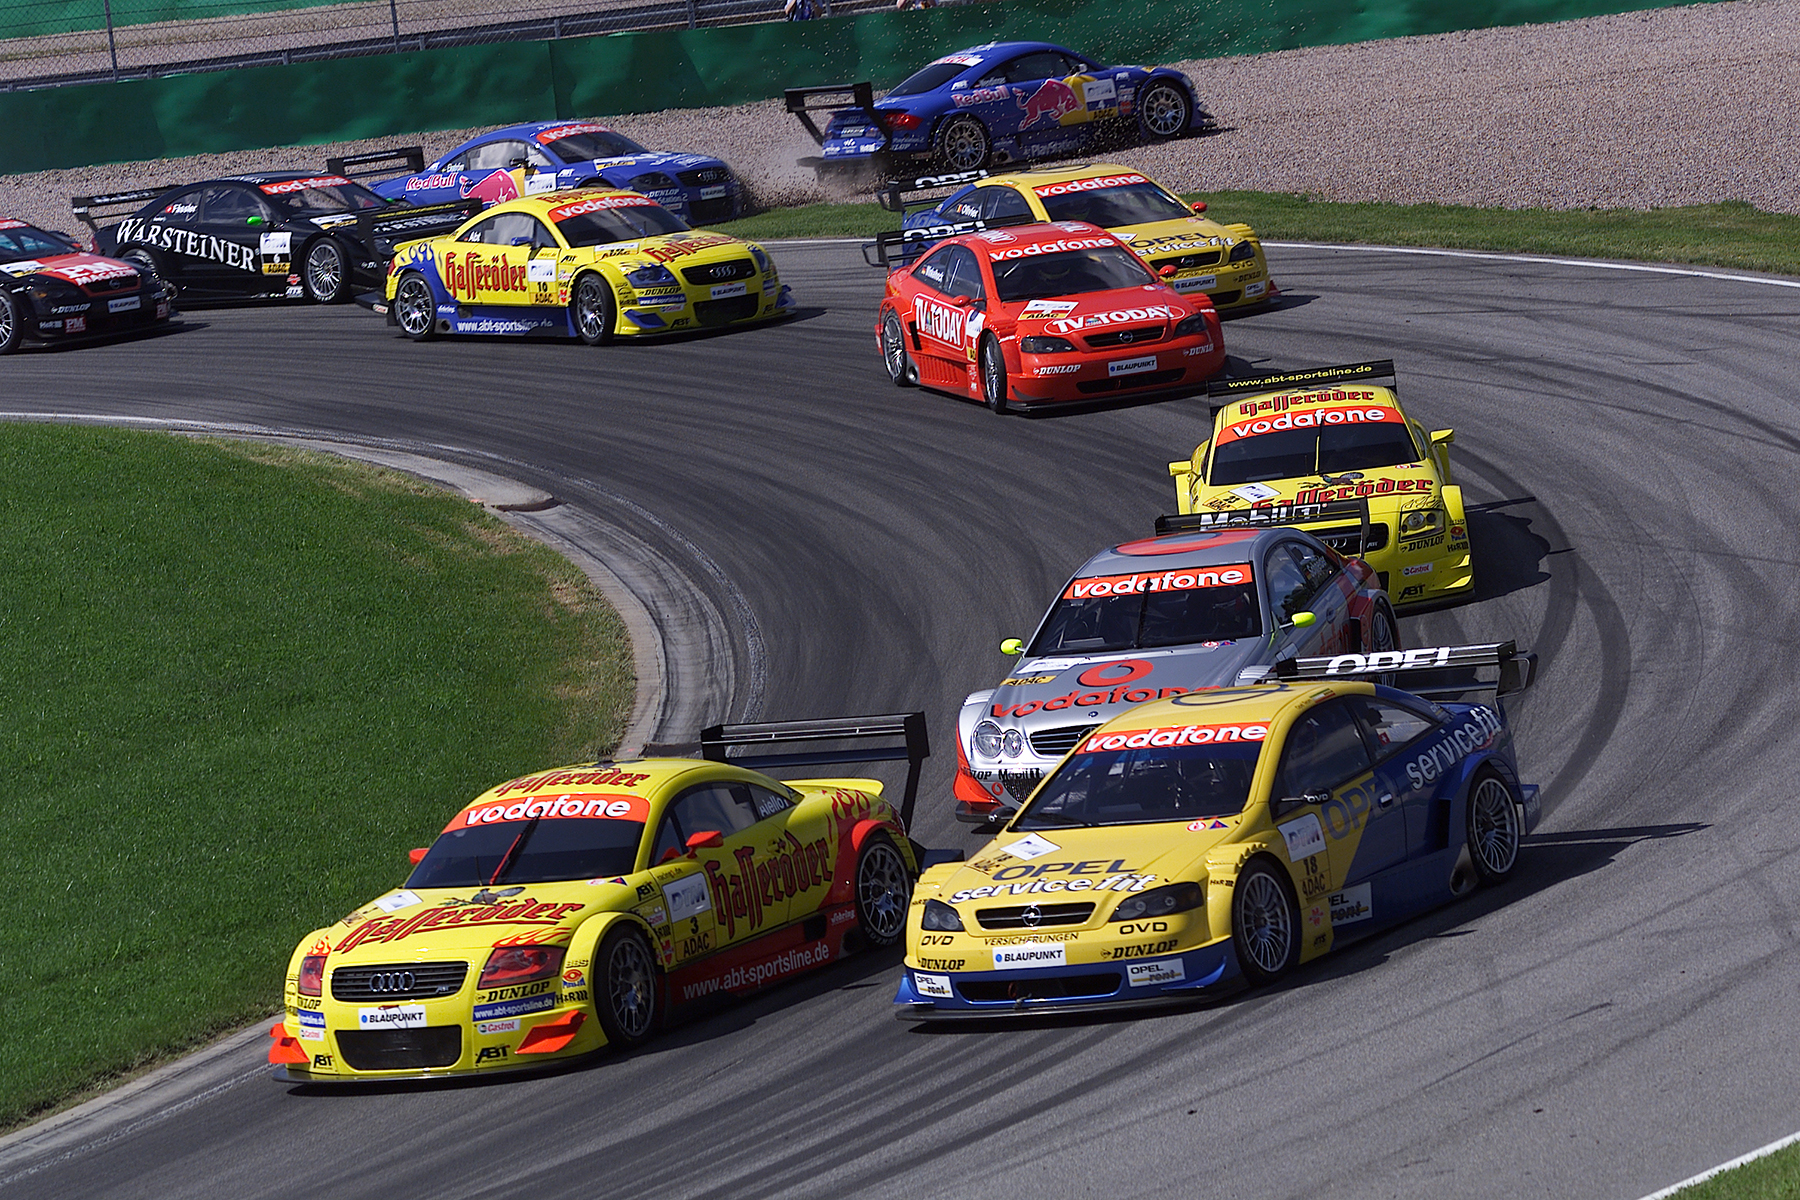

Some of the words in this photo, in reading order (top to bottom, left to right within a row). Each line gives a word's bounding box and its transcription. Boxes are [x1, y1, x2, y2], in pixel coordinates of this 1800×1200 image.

[951, 91, 980, 108] Red
[980, 85, 1011, 104] Bull
[405, 177, 432, 192] Red
[430, 172, 459, 189] Bull
[915, 168, 990, 189] OPEL
[1035, 173, 1147, 198] vodafone
[648, 188, 680, 199] DUNLOP
[556, 195, 652, 218] vodafone
[903, 220, 988, 243] OPEL
[1128, 231, 1220, 249] OPEL
[988, 235, 1116, 262] vodafone
[273, 253, 280, 264] 6
[644, 287, 682, 297] DUNLOP
[1180, 278, 1216, 289] BLAUPUNKT
[56, 303, 91, 314] DUNLOP
[66, 317, 86, 329] PM
[670, 317, 691, 329] ABT
[915, 296, 929, 333] TV
[931, 302, 965, 347] TODAY
[1052, 315, 1086, 334] TV
[1098, 304, 1175, 325] TODAY
[1039, 364, 1081, 375] DUNLOP
[1116, 359, 1156, 372] BLAUPUNKT
[1228, 364, 1373, 389] www.abt-sportsline.de
[1232, 407, 1386, 438] vodafone
[1200, 506, 1288, 531] Mobil
[1408, 534, 1446, 552] DUNLOP
[1409, 564, 1430, 575] Castrol
[1073, 568, 1244, 598] vodafone
[1398, 584, 1425, 600] ABT
[1326, 646, 1451, 675] OPEL
[1009, 675, 1047, 687] ADAC
[1085, 723, 1268, 752] vodafone
[465, 793, 632, 826] vodafone
[758, 795, 785, 818] Aiello
[1288, 823, 1321, 851] DTM
[992, 858, 1141, 881] OPEL
[1303, 856, 1319, 876] 18
[636, 882, 656, 902] ABT
[1302, 874, 1326, 897] ADAC
[671, 882, 706, 913] DTM
[690, 916, 700, 935] 3
[1119, 921, 1168, 935] OVD
[683, 932, 710, 958] ADAC
[921, 935, 955, 946] OVD
[983, 932, 1080, 947] VERSICHERUNGEN
[1111, 938, 1179, 960] DUNLOP
[565, 959, 590, 969] BBS
[920, 957, 966, 971] DUNLOP
[1003, 949, 1064, 963] BLAUPUNKT
[682, 940, 830, 1000] www.abt-sportsline.de
[1130, 964, 1164, 975] OPEL
[916, 974, 936, 985] OPEL
[486, 980, 551, 1003] DUNLOP
[926, 984, 946, 996] rent
[369, 1011, 425, 1024] BLAUPUNKT
[473, 997, 554, 1020] www.abt-sportsline.de
[486, 1021, 516, 1033] Castrol
[313, 1053, 333, 1069] ABT
[475, 1045, 511, 1064] ABT
